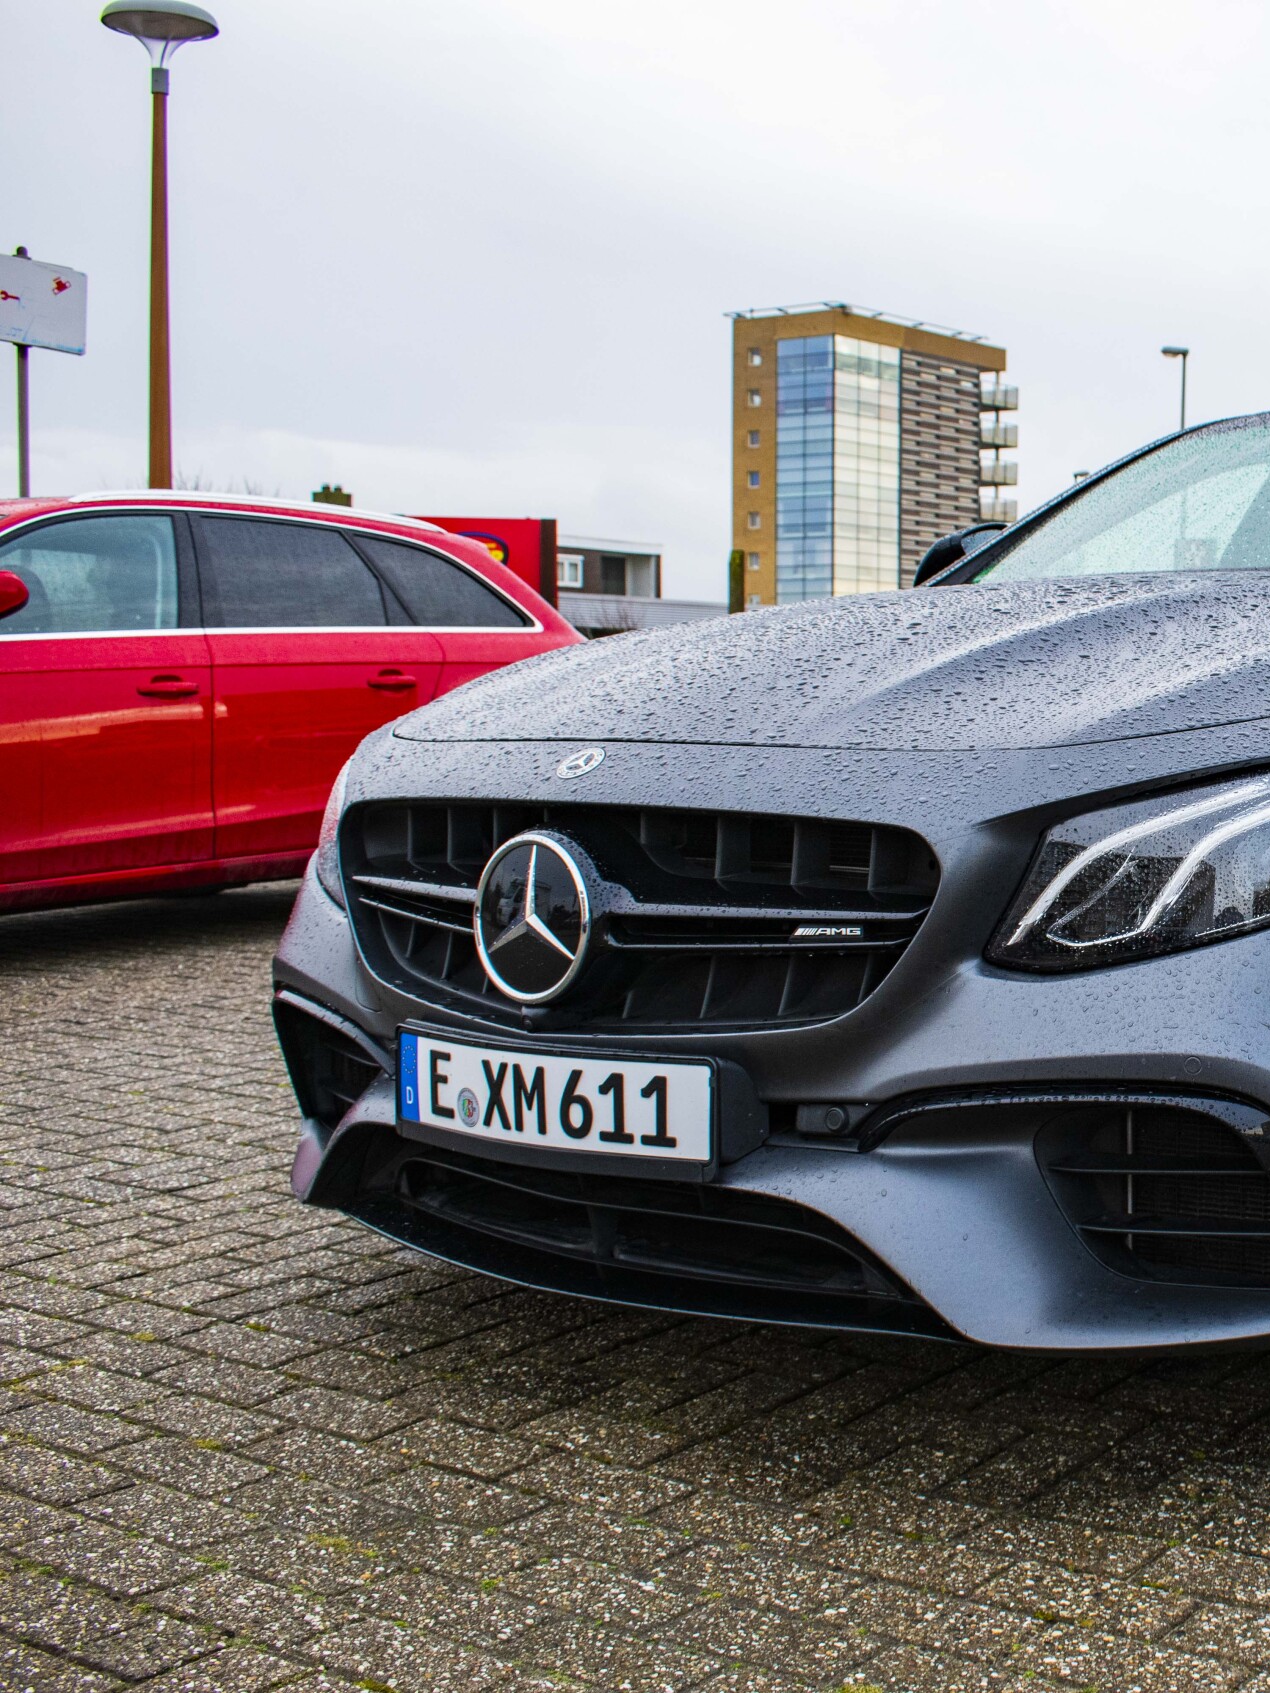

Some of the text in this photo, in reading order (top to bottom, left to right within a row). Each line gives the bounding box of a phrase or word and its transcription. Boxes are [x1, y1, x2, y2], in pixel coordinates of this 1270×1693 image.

[815, 927, 861, 936] AMG
[405, 1086, 414, 1104] D
[429, 1048, 678, 1148] E XM 611
